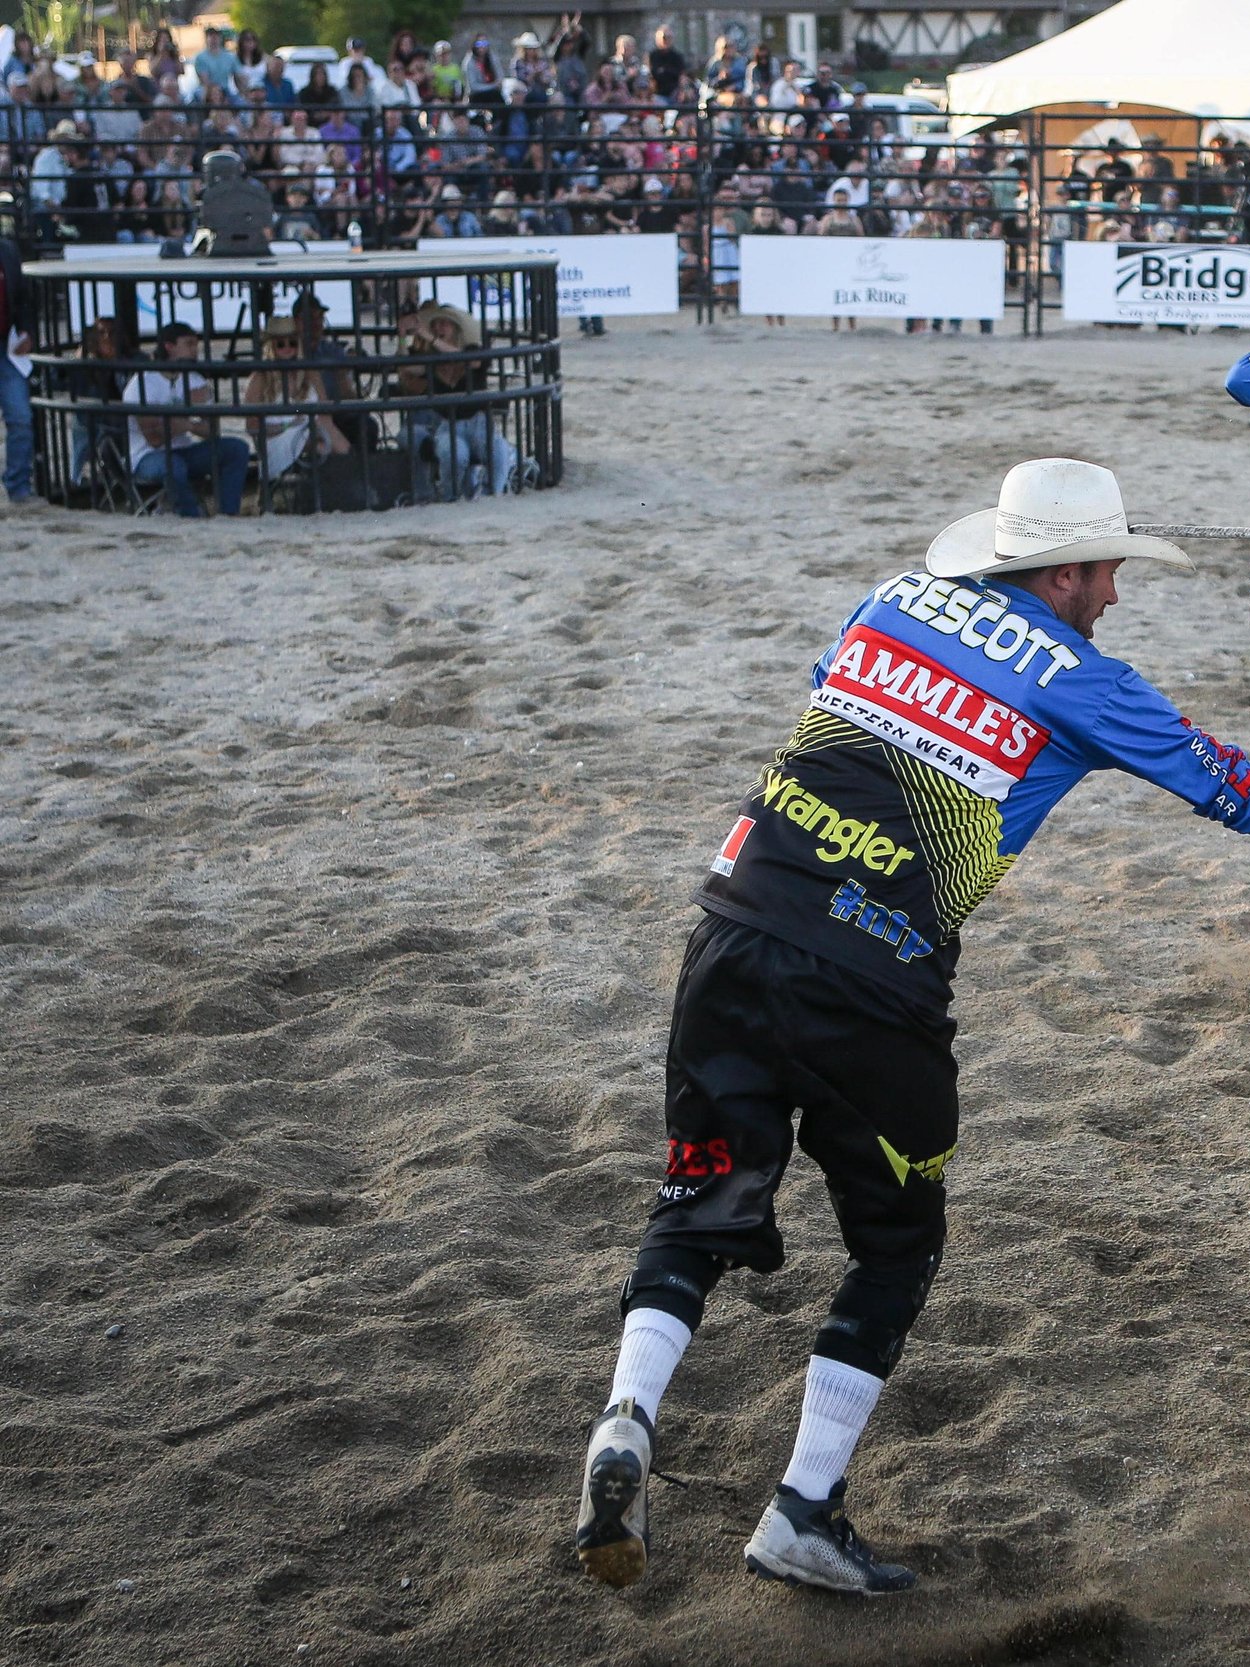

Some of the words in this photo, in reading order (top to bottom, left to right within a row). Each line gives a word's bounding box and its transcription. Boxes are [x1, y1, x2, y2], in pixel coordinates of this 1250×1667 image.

[1142, 289, 1220, 303] CARRIERS
[828, 639, 1037, 760] AMMLE'S
[915, 734, 980, 780] WEAR
